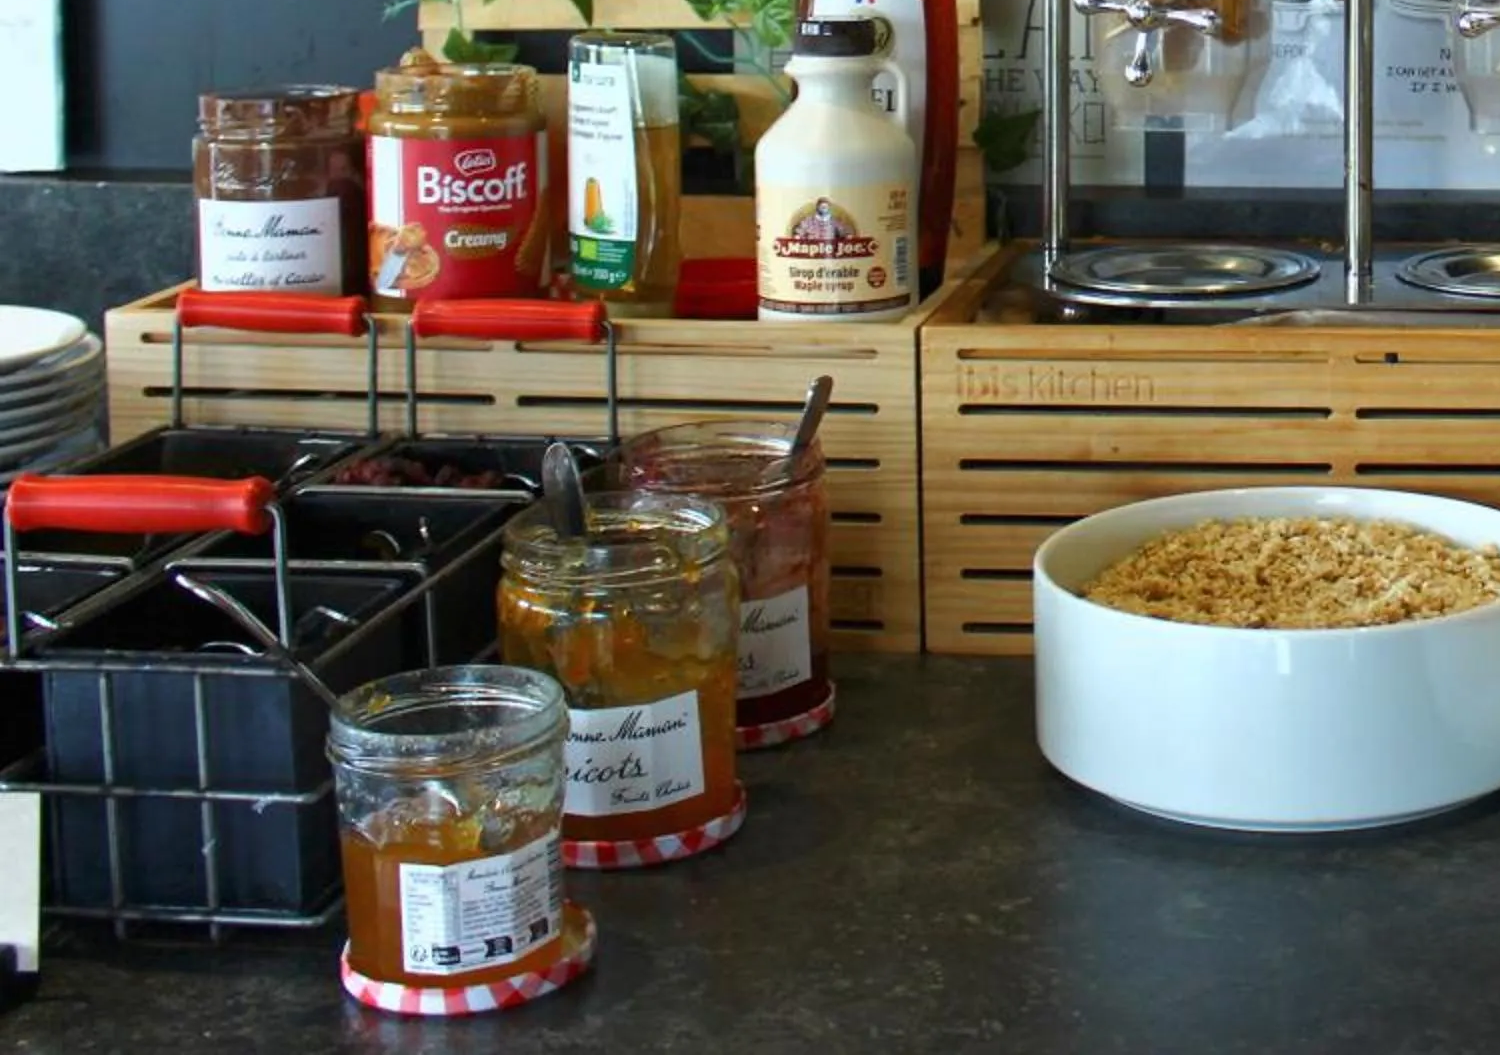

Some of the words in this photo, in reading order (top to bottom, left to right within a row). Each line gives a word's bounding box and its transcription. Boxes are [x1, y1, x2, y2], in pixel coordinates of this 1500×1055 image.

[984, 68, 1026, 93] HE
[417, 162, 528, 204] Biscoff
[445, 230, 507, 249] Creamy
[956, 364, 1019, 397] ibis
[1028, 367, 1156, 402] kitchen
[566, 752, 648, 784] icots
